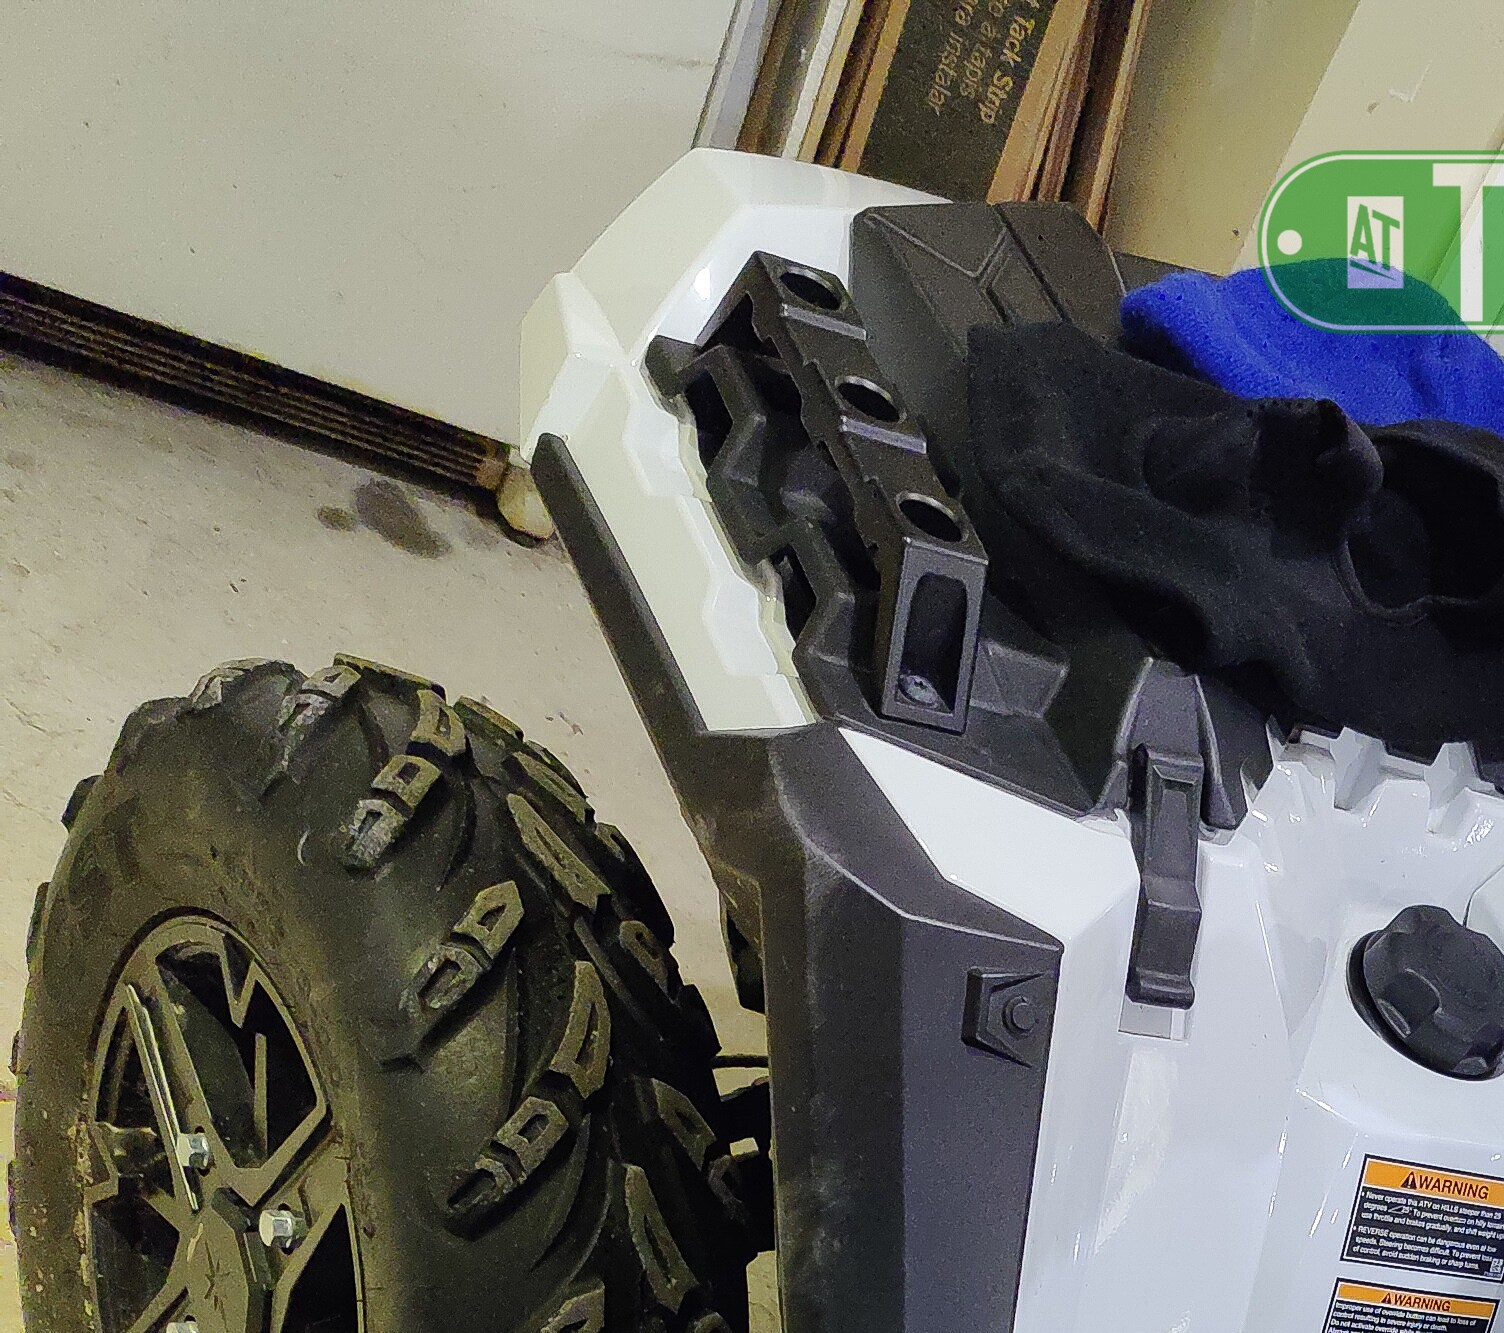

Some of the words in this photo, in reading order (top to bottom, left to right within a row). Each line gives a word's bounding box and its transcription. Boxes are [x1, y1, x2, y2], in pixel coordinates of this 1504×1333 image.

[1001, 16, 1036, 68] Tack
[978, 70, 1014, 124] Strip
[1419, 1175, 1489, 1199] WARNING
[1357, 1225, 1389, 1237] REVERSE
[1394, 1294, 1451, 1312] WARNING
